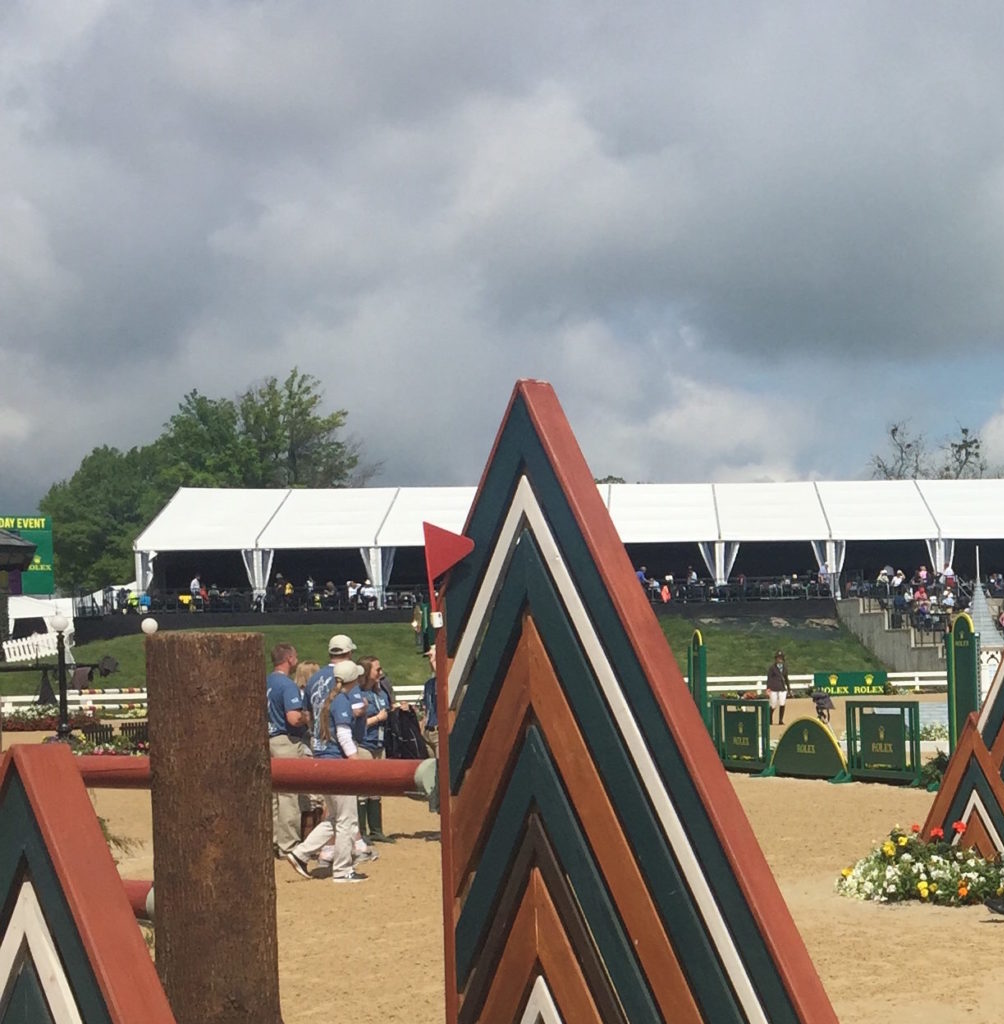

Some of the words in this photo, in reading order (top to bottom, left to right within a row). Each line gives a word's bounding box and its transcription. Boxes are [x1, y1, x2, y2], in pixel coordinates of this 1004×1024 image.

[17, 517, 46, 528] EVENT
[854, 685, 884, 694] ROLEX
[797, 744, 815, 754] ROLEX
[871, 743, 893, 753] ROLEX
